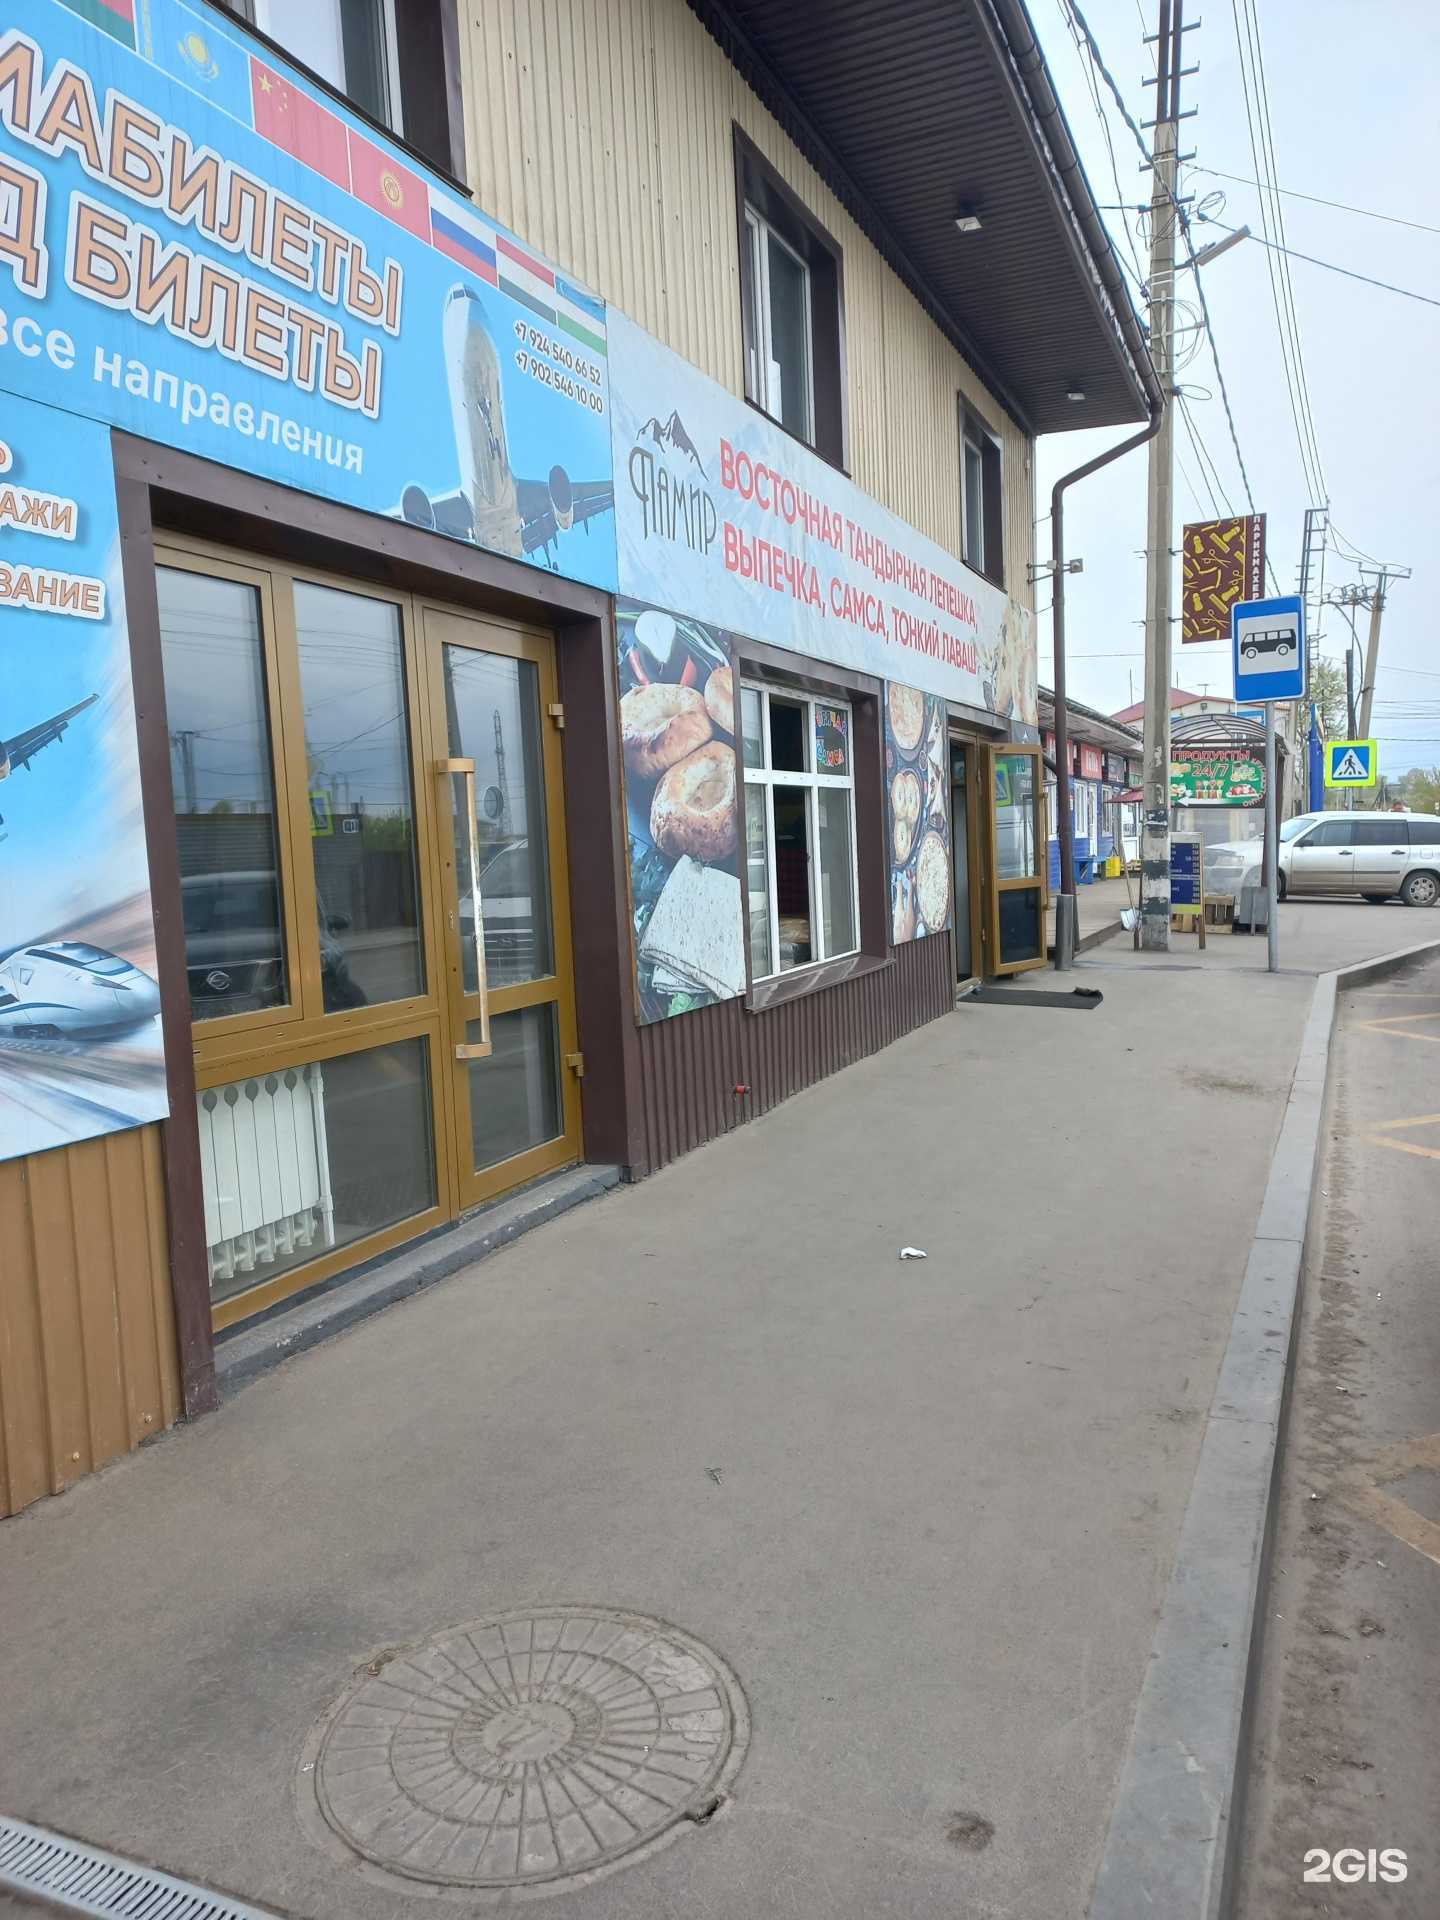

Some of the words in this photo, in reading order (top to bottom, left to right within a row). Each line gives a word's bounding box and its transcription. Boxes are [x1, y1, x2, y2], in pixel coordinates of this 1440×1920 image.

[73, 200, 379, 412] БИЛЕТЫ
[514, 321, 527, 342] +7
[529, 328, 550, 357] 924
[552, 342, 573, 369] 540
[575, 356, 588, 378] 66
[589, 364, 602, 387] 52
[93, 346, 364, 474] направления
[516, 351, 528, 372] +7
[530, 358, 552, 386] 902
[554, 370, 574, 398] 546
[576, 384, 588, 405] 10
[589, 392, 604, 414] 00
[720, 437, 844, 553] ВОСТОЧНАЯ
[847, 519, 927, 601] ТАНДЫРНАЯ
[930, 572, 978, 634] ЛЕПЕШКА,
[724, 520, 826, 618] ВЫПЕЧКА,
[830, 576, 889, 645] САМСА,
[892, 606, 941, 660] ТОНКИЙ
[942, 631, 977, 675] ЛАВАШ
[1172, 750, 1251, 762] ПРОДУКТЫ
[1191, 763, 1229, 777] 24/7
